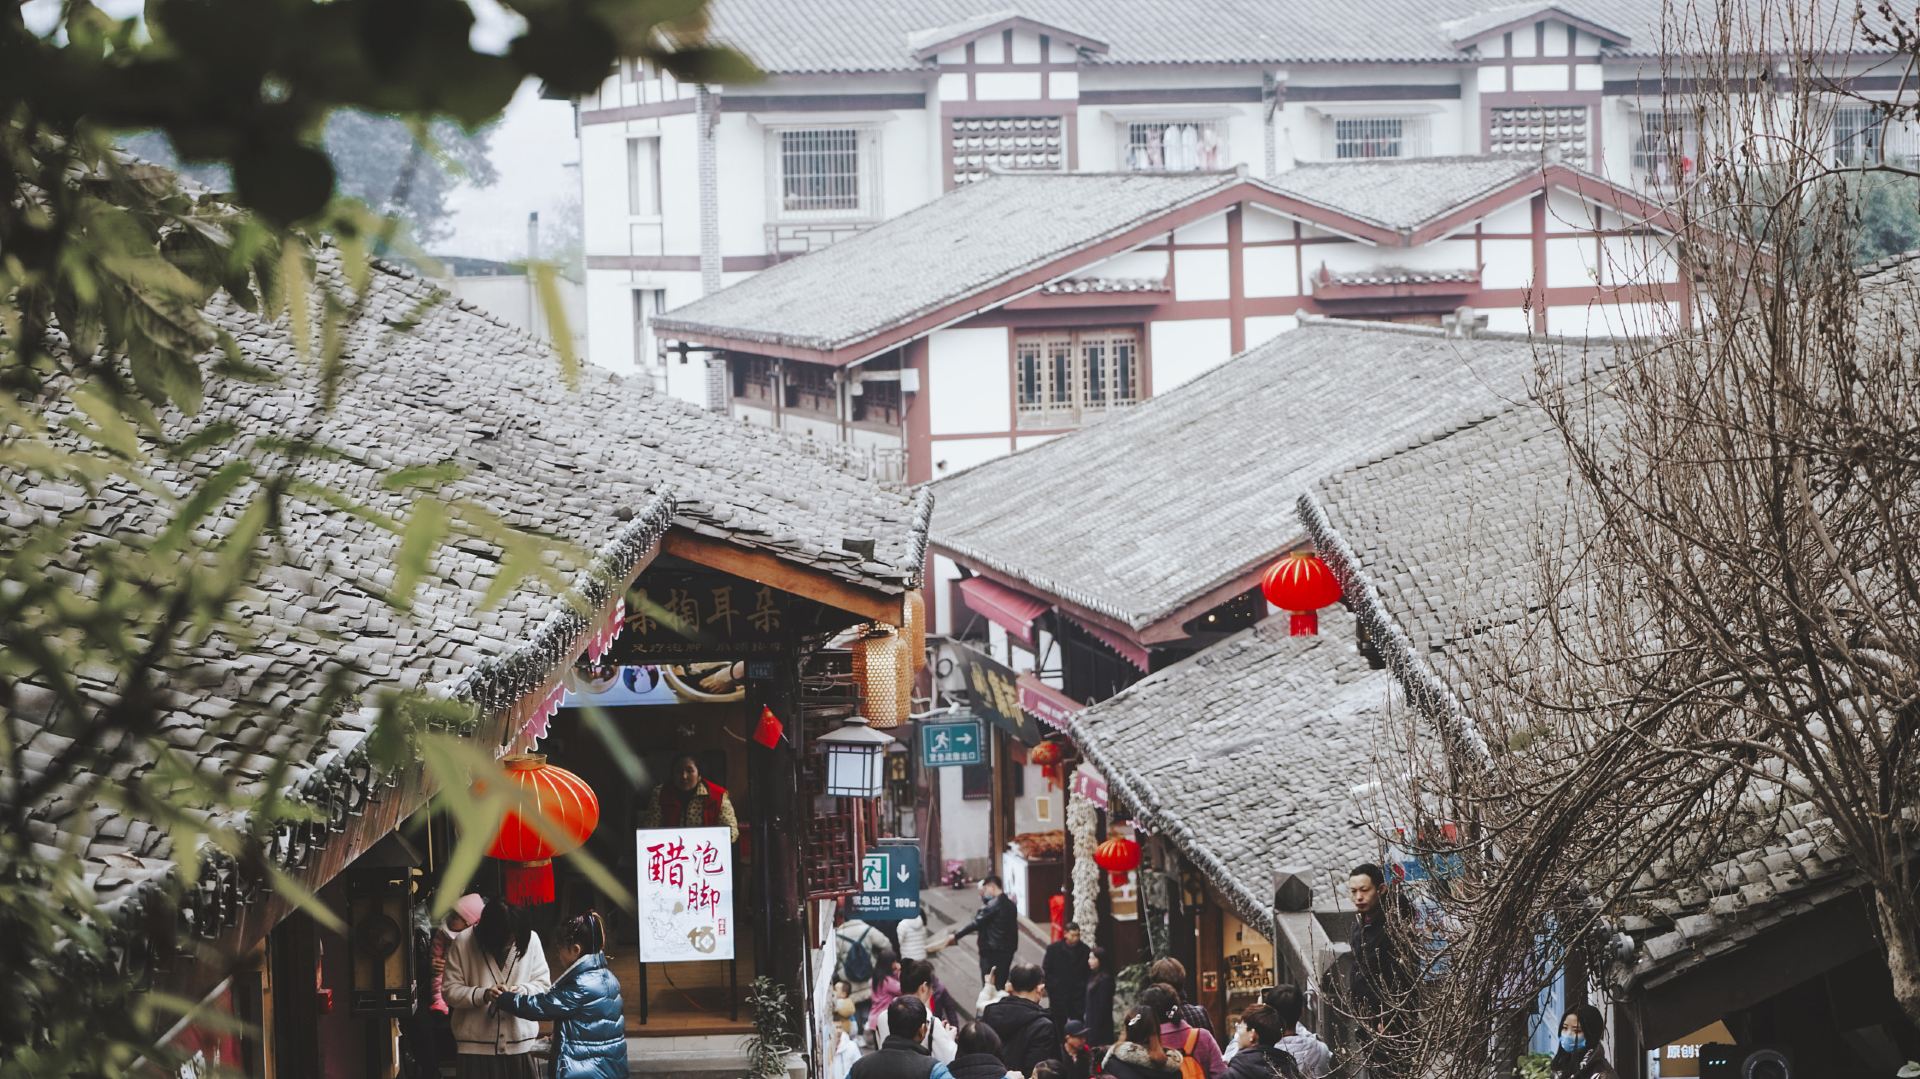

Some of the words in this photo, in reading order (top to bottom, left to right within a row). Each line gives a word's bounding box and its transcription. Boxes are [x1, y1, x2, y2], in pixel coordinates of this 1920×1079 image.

[646, 836, 690, 889] 醋
[687, 840, 724, 919] 泡脚
[894, 898, 917, 908] 100m
